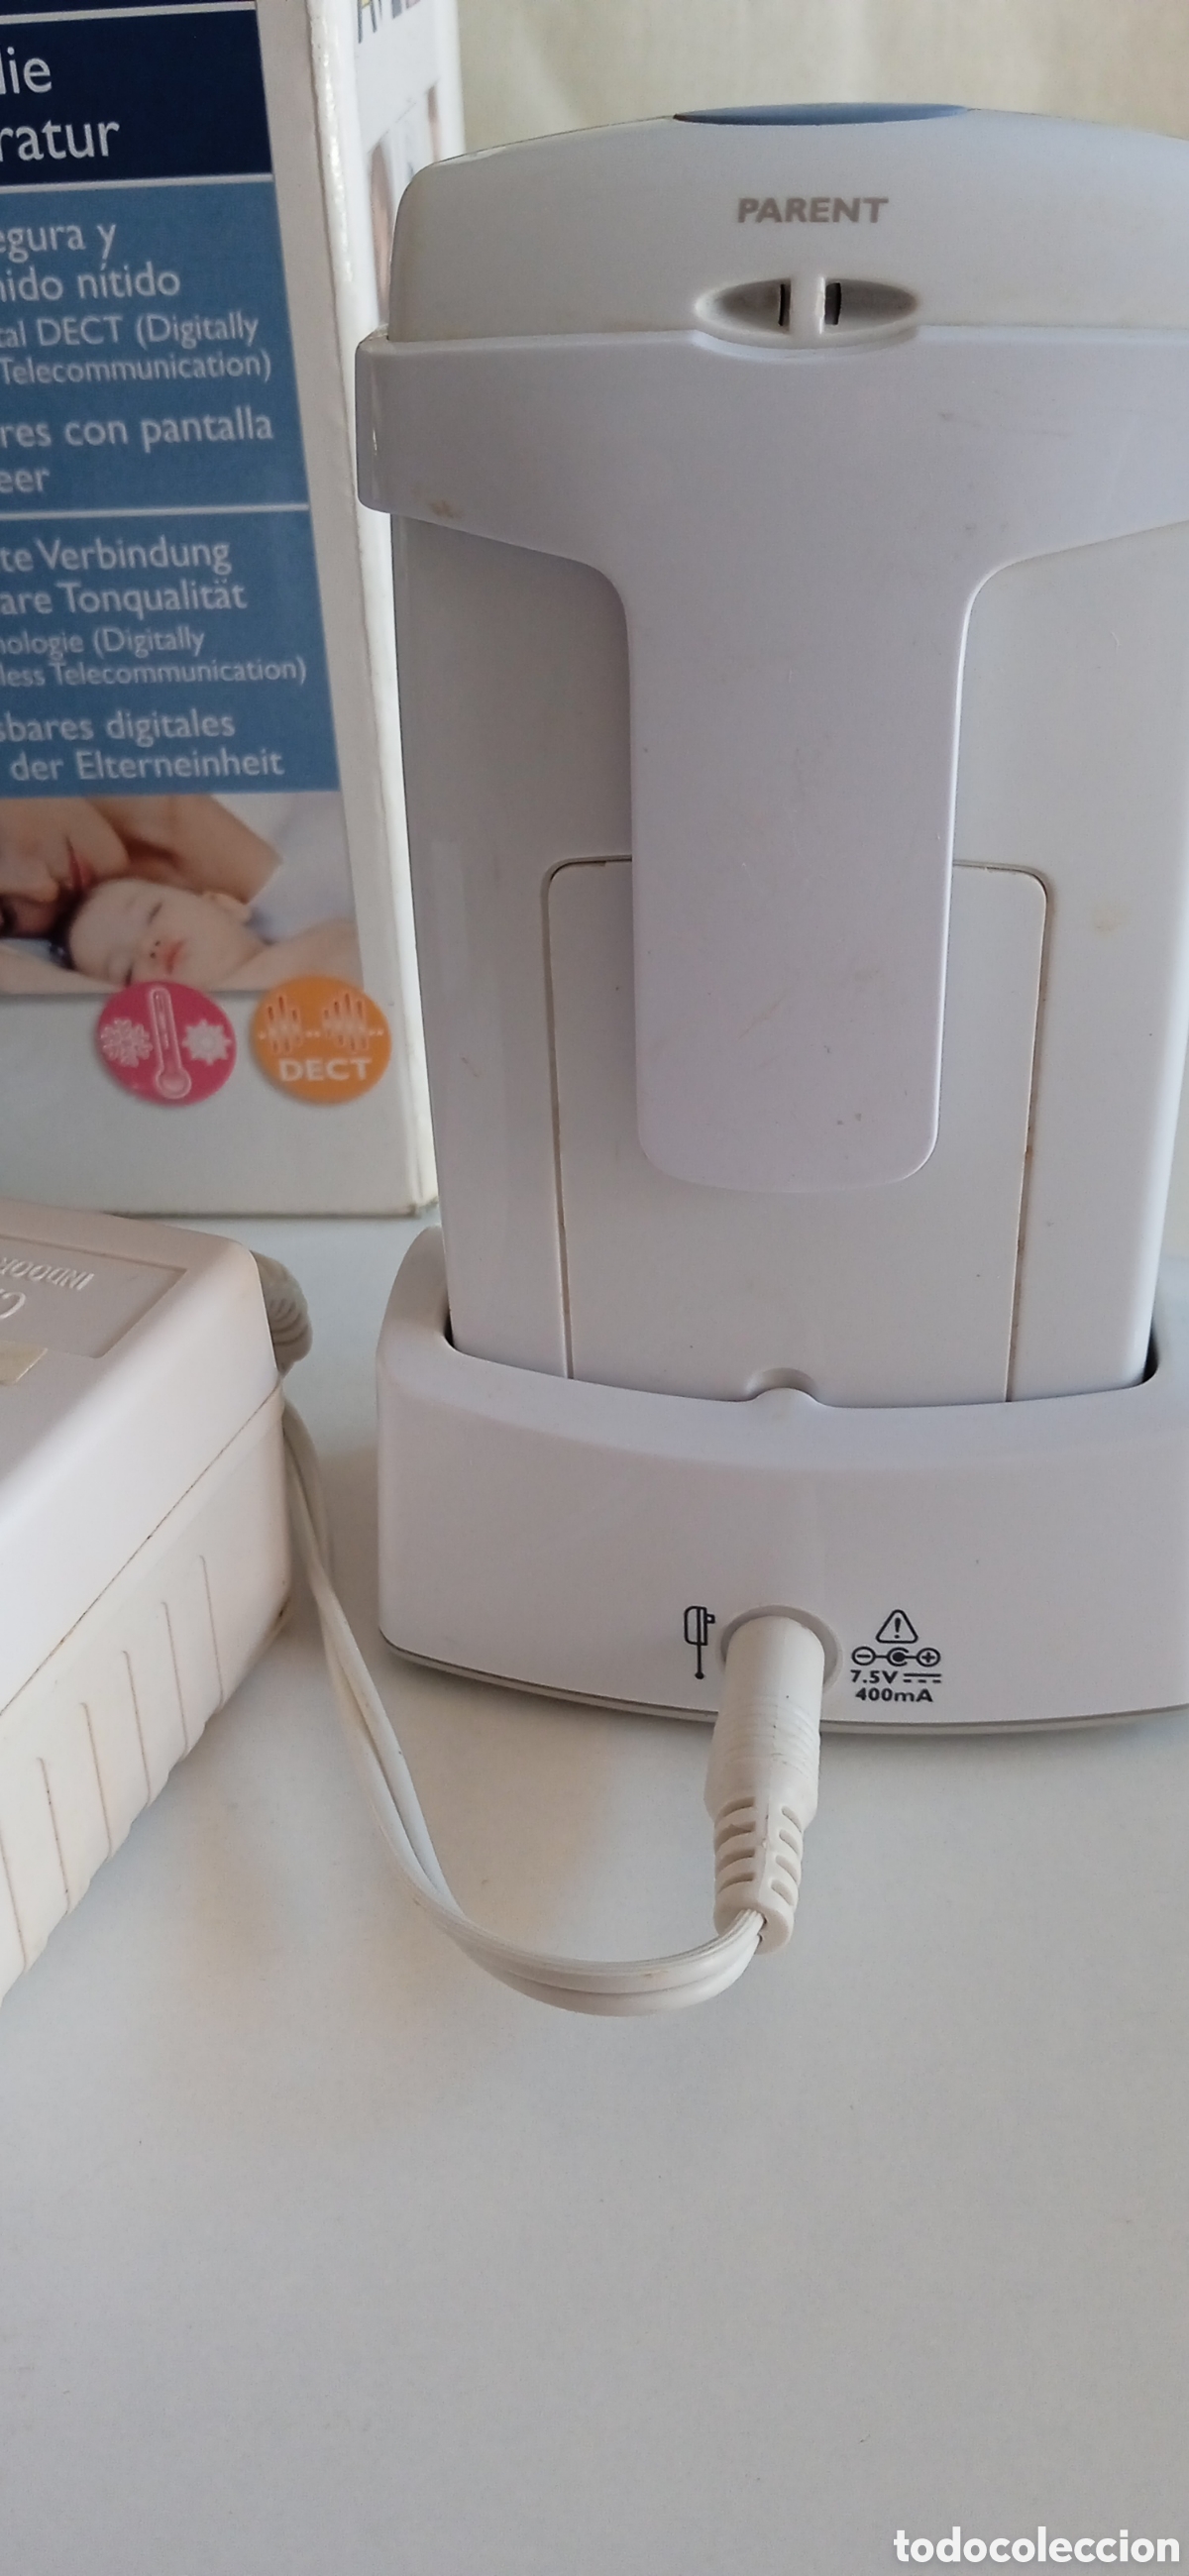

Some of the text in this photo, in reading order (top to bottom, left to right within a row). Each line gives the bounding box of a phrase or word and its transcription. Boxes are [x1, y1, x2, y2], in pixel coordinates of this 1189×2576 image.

[0, 46, 53, 95] ie
[0, 120, 121, 162] ratur
[737, 196, 890, 224] PARENT
[96, 222, 117, 262] y
[77, 261, 181, 300] nítido
[38, 314, 124, 346] DECT
[136, 310, 259, 352] (Digitally
[0, 351, 272, 385] Telecommunication)
[0, 406, 274, 454] res con pantalla
[0, 535, 233, 575] te Verbindung
[0, 578, 249, 620] are Tonqualität
[93, 624, 205, 661] (Digitally
[50, 655, 307, 688] Telecommunication)
[106, 708, 236, 748] digitales
[10, 747, 285, 782] der Elterneinheit
[278, 1056, 373, 1082] DECT
[850, 1668, 899, 1684] 7.5V
[855, 1686, 934, 1703] 400mA
